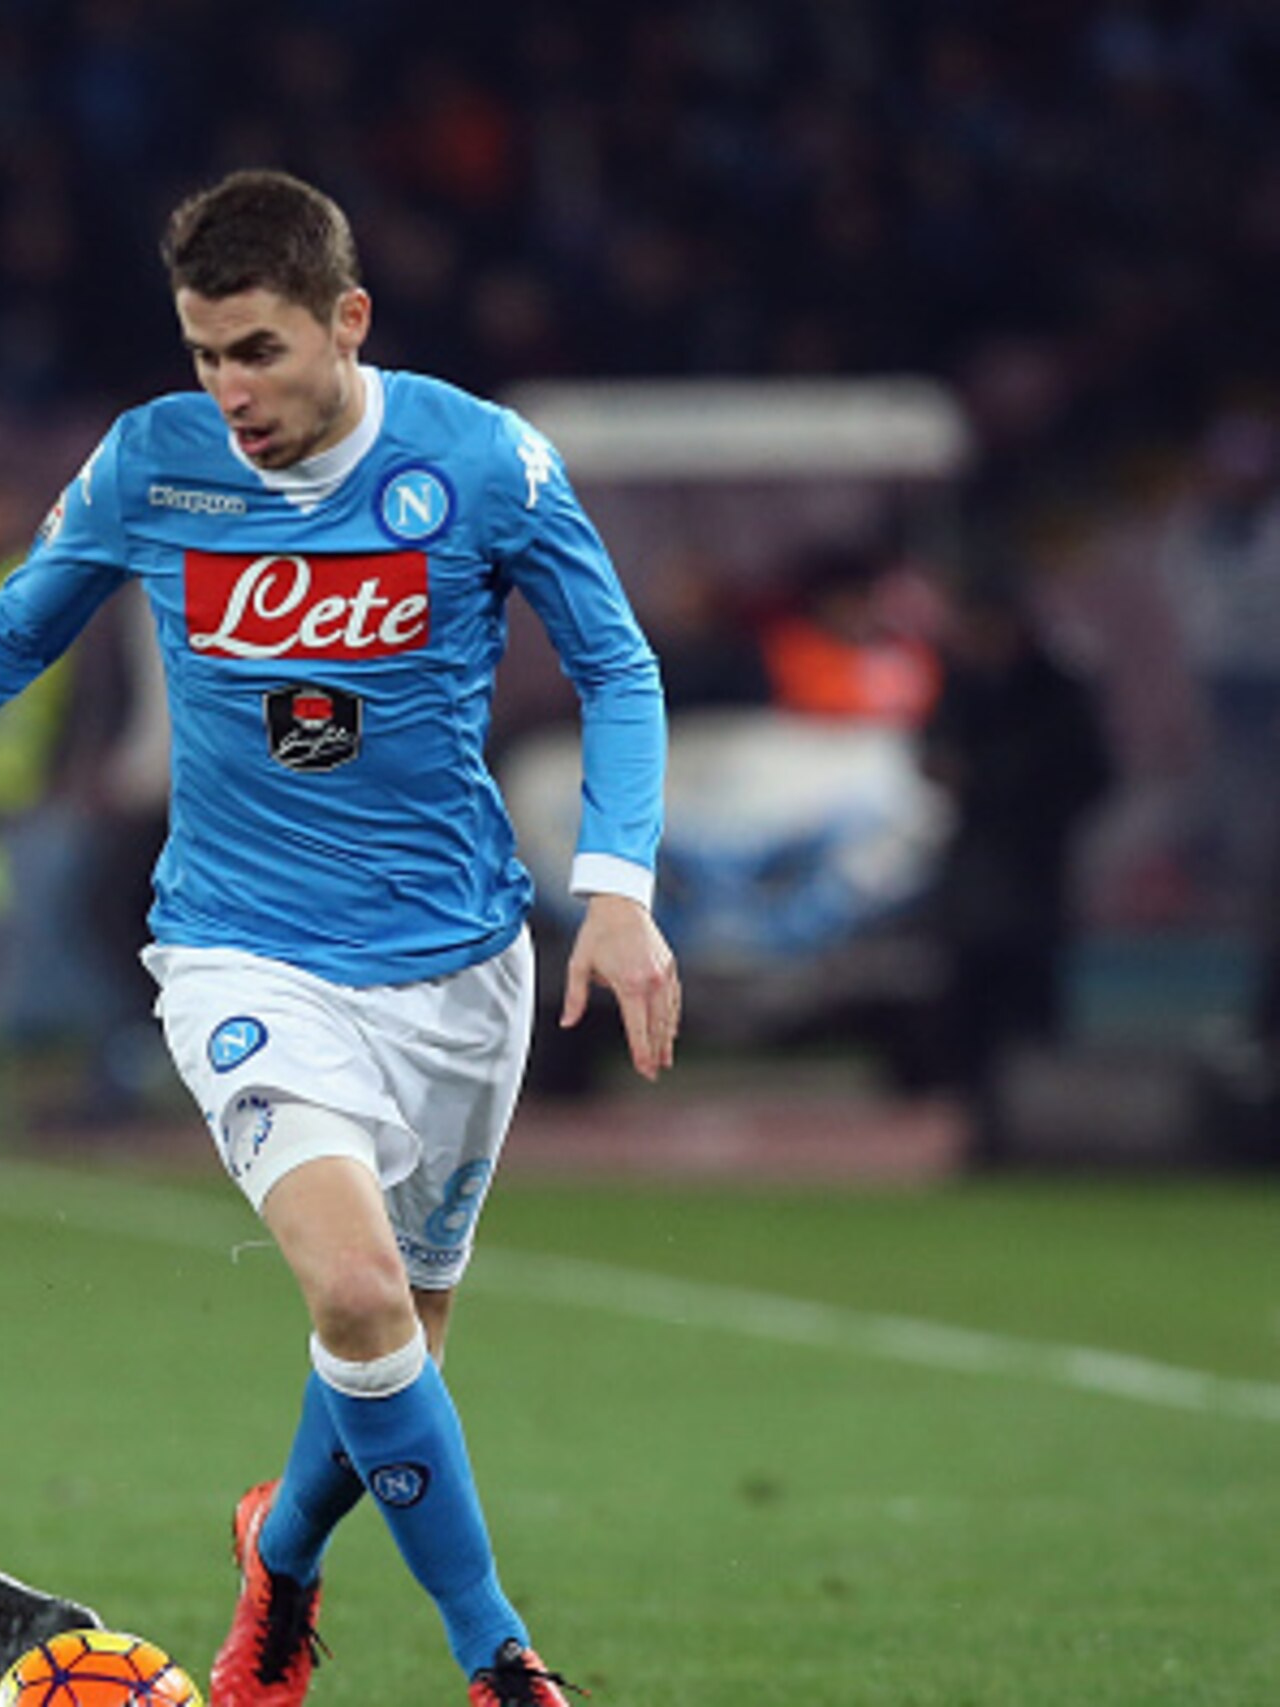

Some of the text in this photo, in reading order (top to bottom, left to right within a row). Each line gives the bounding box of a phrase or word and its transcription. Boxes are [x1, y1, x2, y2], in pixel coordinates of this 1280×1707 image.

[395, 482, 432, 526] N
[188, 553, 428, 659] Lete
[424, 1157, 491, 1248] 8
